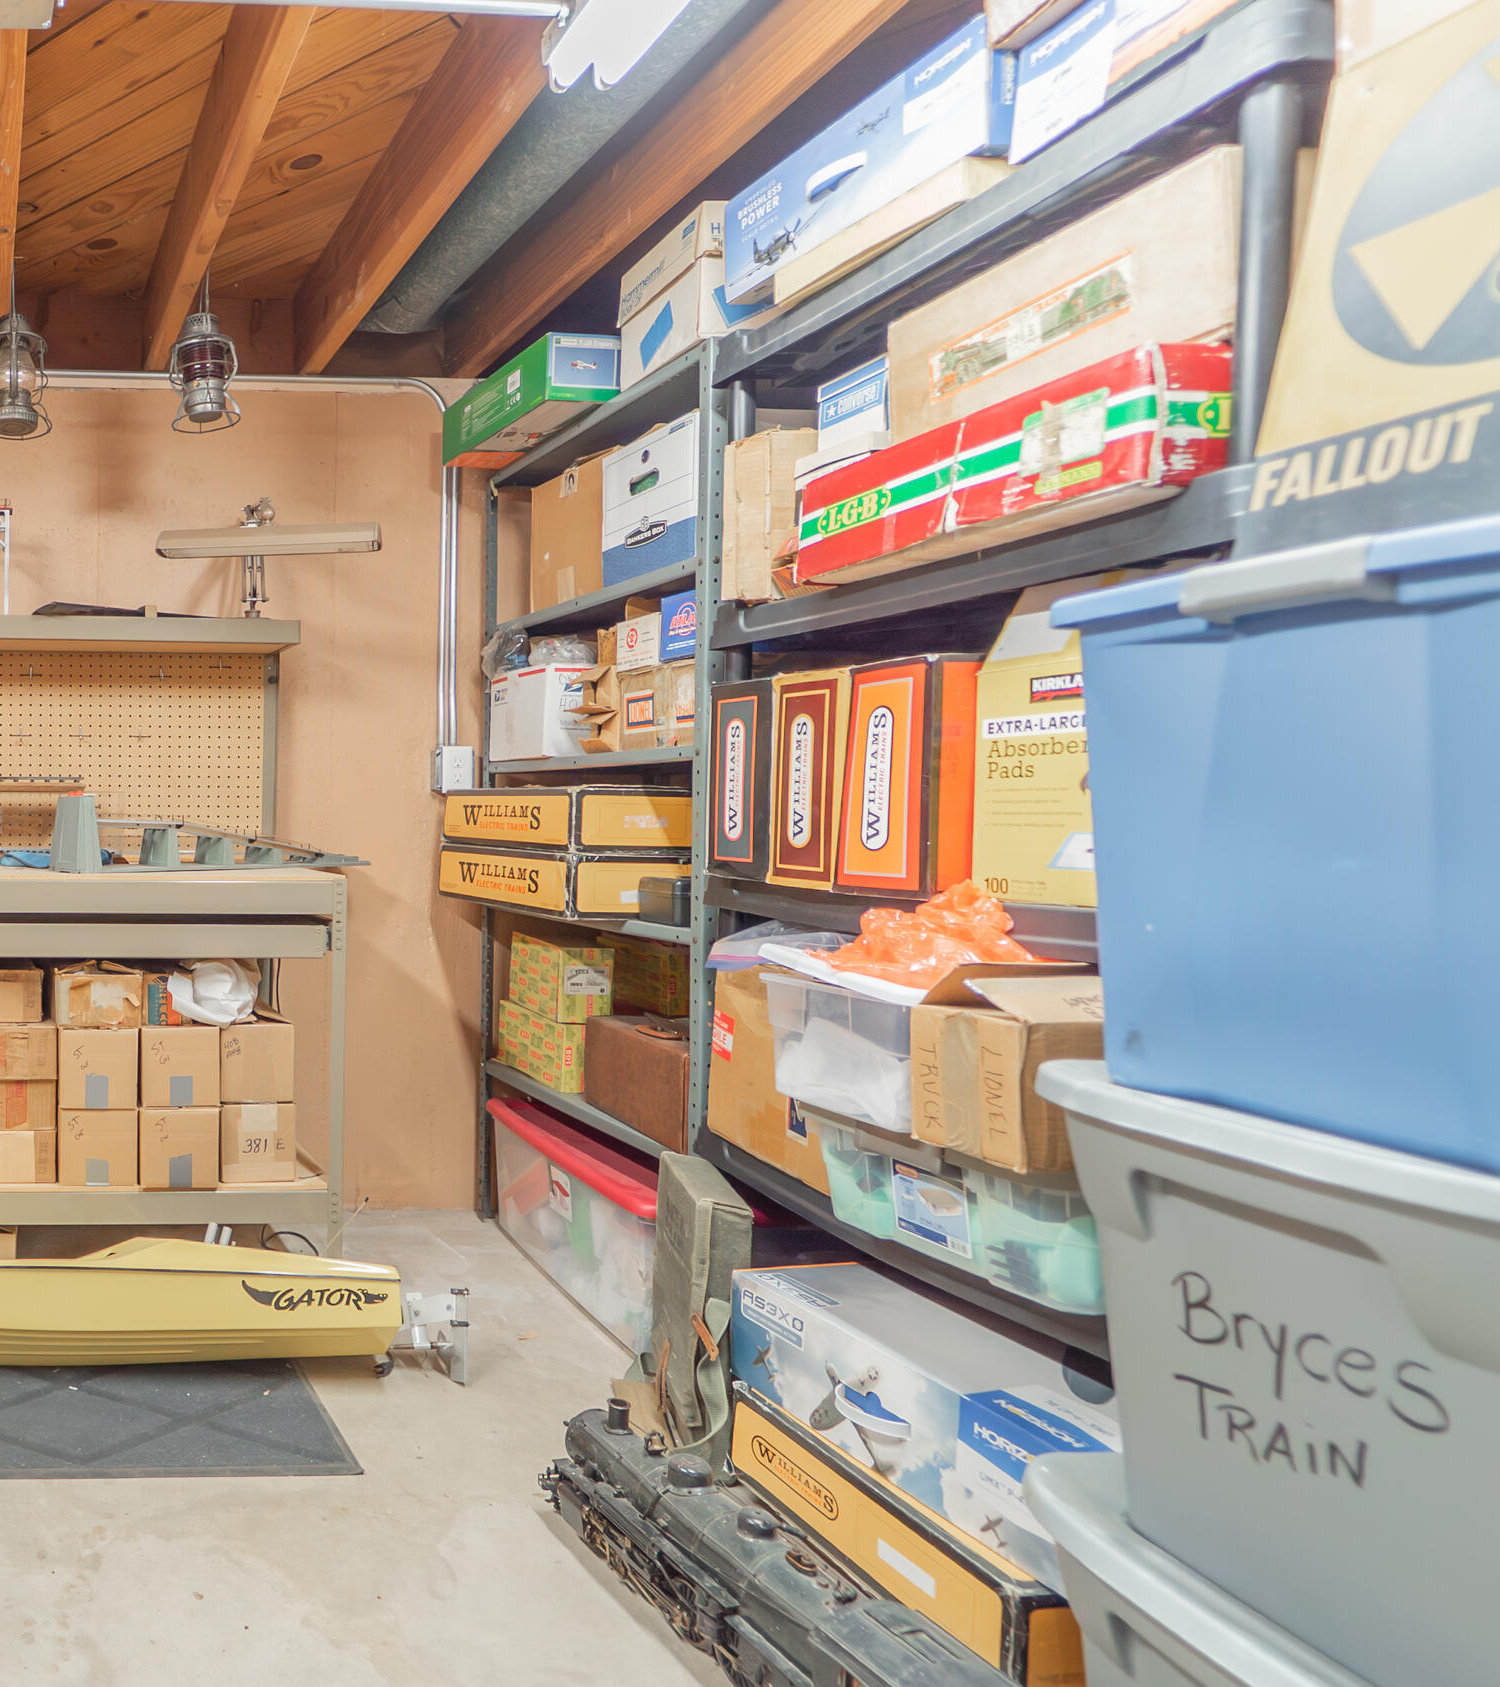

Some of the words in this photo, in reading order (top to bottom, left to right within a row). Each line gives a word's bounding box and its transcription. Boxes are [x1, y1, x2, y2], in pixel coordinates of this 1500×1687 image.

[737, 182, 782, 220] BRUSHLESS
[741, 195, 779, 230] POWER
[1250, 402, 1494, 512] FALLOUT
[627, 530, 652, 544] BANKERS
[652, 525, 665, 536] BOX
[1032, 673, 1084, 692] KIRKLA
[728, 725, 741, 833] WILLIAMS
[792, 721, 808, 840] WILLIAMS
[866, 713, 887, 843] WILLIAMS
[987, 761, 1035, 779] Pads
[463, 804, 541, 831] WILLIAMS
[479, 821, 506, 830] ELECTRIC
[507, 822, 529, 832] TRAINS
[459, 862, 539, 894] WILLIAMS
[476, 879, 503, 891] ELECTRIC
[504, 883, 527, 895] TRAINS
[984, 877, 1009, 894] 100
[919, 1042, 943, 1129] TRUCK
[242, 1138, 268, 1153] 381
[276, 1138, 286, 1150] E
[274, 1288, 363, 1311] GATOR
[1171, 1270, 1450, 1434] Bryces
[756, 1440, 834, 1513] WILLIAMS
